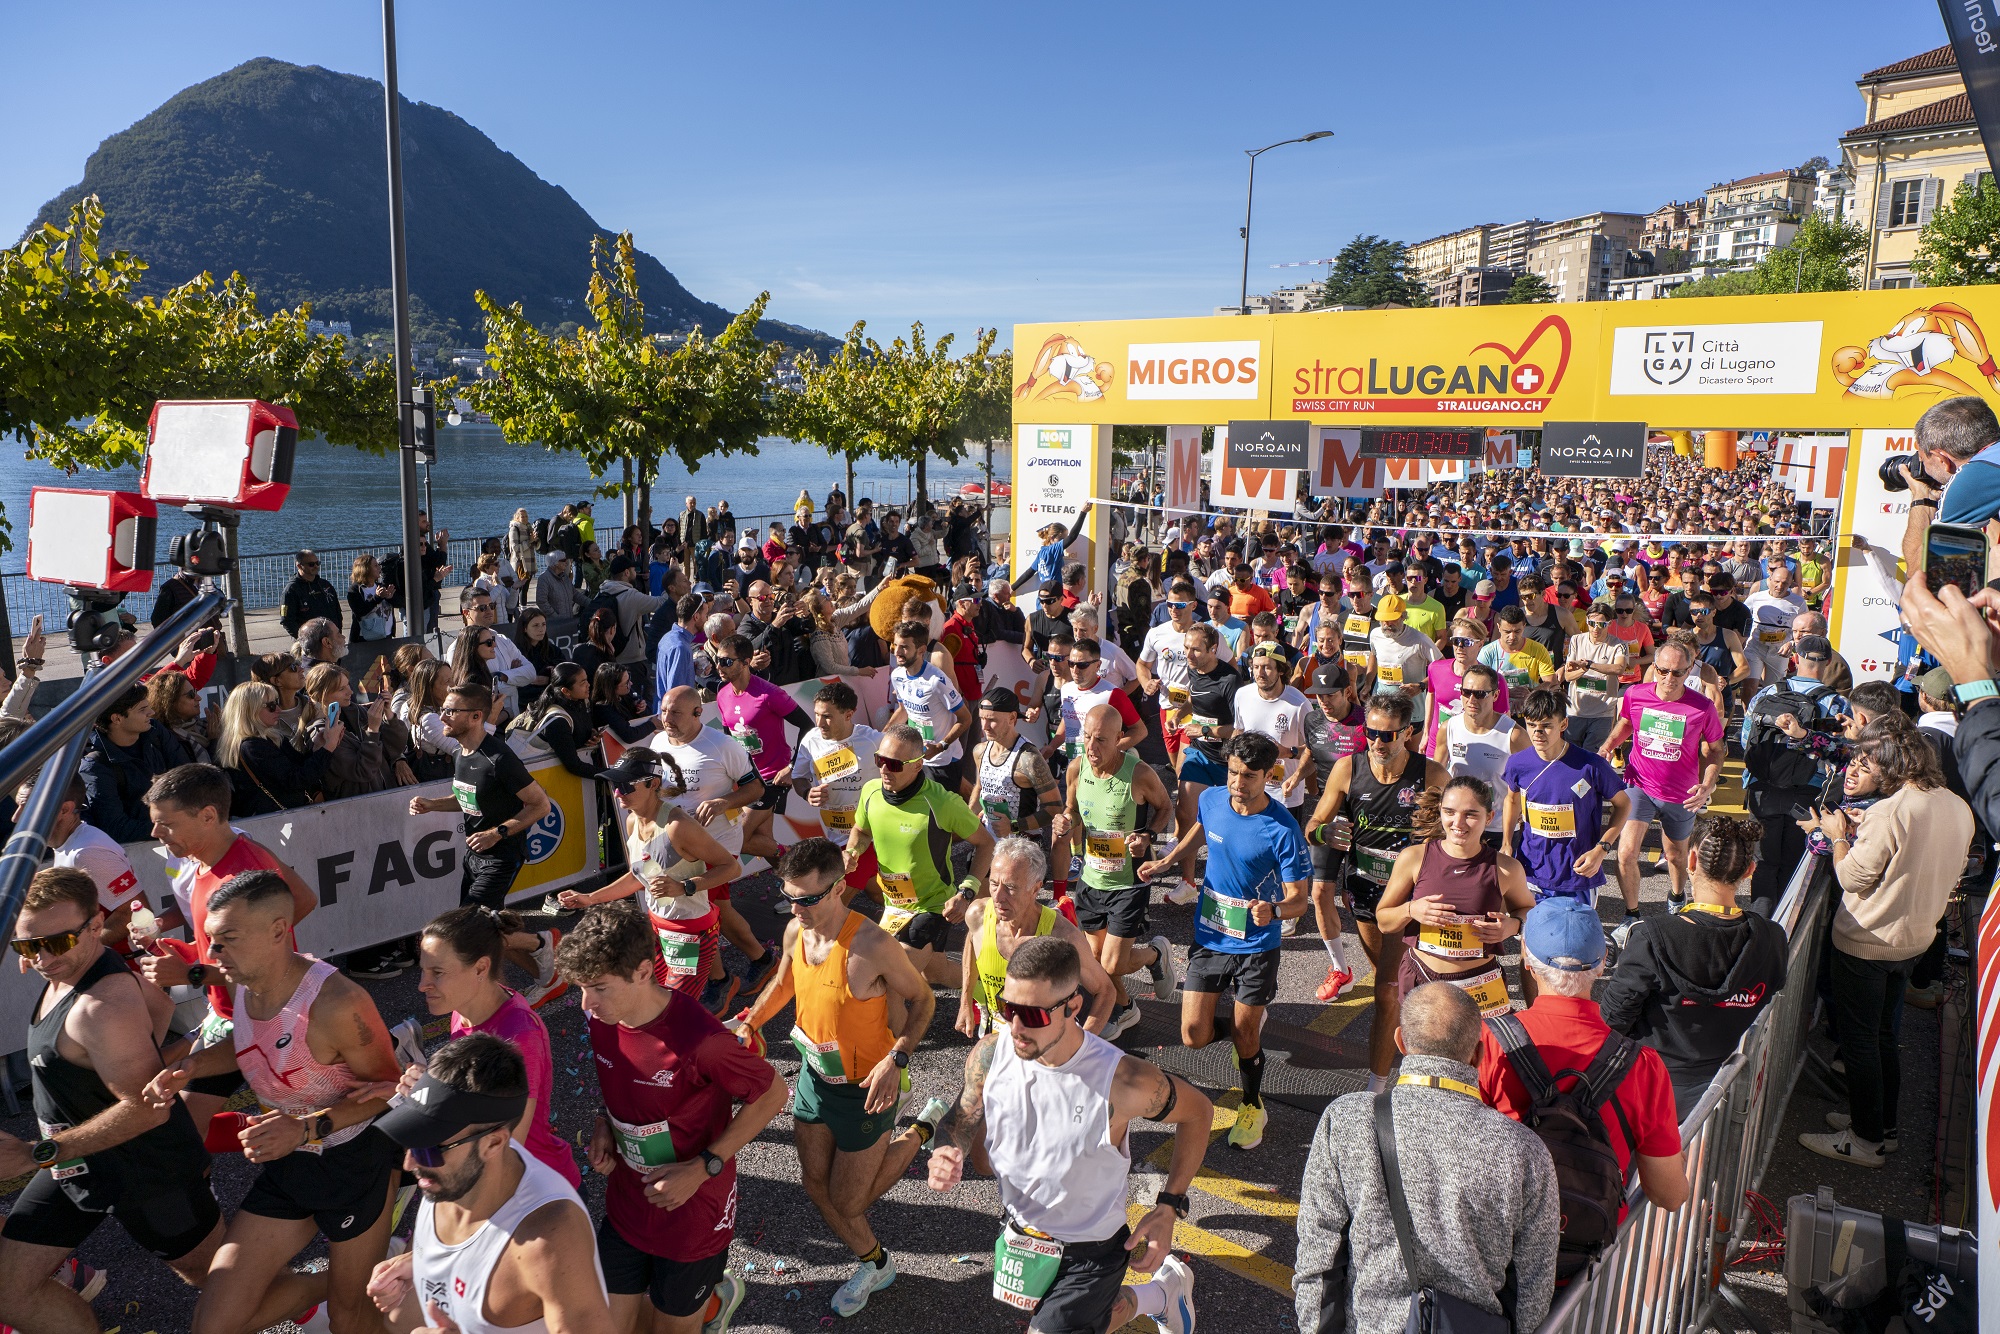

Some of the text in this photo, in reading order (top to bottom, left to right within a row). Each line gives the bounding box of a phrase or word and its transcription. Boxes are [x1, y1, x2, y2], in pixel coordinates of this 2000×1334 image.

[1702, 339, 1739, 353] Città
[1700, 357, 1776, 373] di Lugano
[1129, 357, 1257, 385] MIGROS
[1699, 376, 1774, 386] Dicastero Sport
[1295, 400, 1375, 411] SWISS CITY RUN
[1437, 400, 1542, 411] STRALUGANO.CH
[1040, 431, 1069, 443] NON
[1235, 443, 1301, 452] NORQAIN
[1380, 432, 1470, 454] 10:03:05
[1550, 447, 1634, 458] NORQAIN
[1037, 458, 1082, 467] DECATHLON
[1041, 504, 1076, 515] TELF AG
[1654, 721, 1669, 731] 1331
[826, 757, 841, 768] 7527
[832, 815, 846, 824] 7527
[1540, 816, 1558, 825] 7537
[1093, 843, 1110, 852] 7563
[1371, 861, 1387, 871] 168
[1230, 900, 1245, 908] 2025
[1214, 907, 1227, 918] 217
[1217, 925, 1243, 938] MIGROS
[1438, 928, 1463, 940] 7536
[1438, 939, 1463, 949] LAURA
[1448, 949, 1480, 957] MIGROS
[1483, 972, 1498, 983] 2025
[816, 1044, 834, 1052] 2025
[641, 1125, 663, 1137] 2025
[624, 1140, 641, 1155] 151
[1006, 1246, 1036, 1259] MARATHON
[1033, 1243, 1056, 1256] 2025
[1001, 1256, 1025, 1278] 146
[995, 1270, 1025, 1293] GILLES
